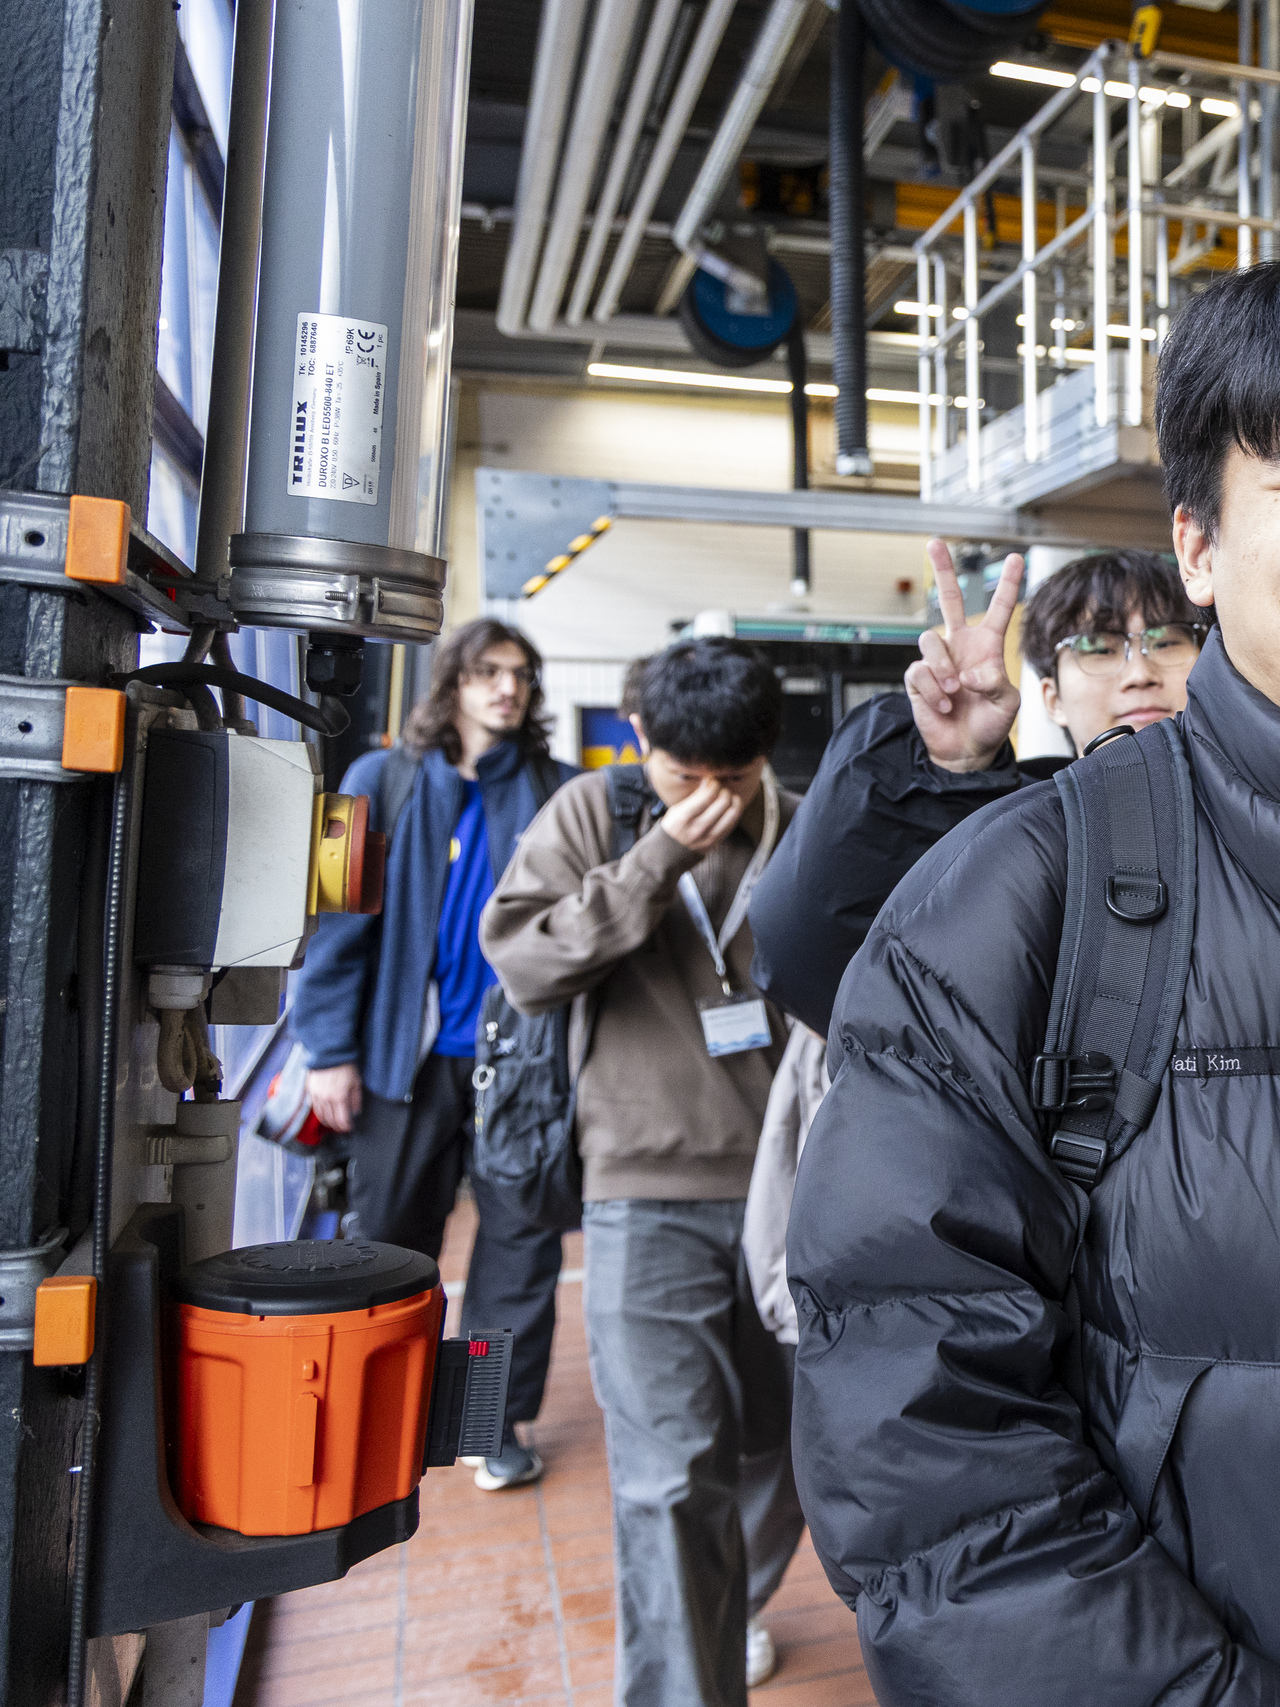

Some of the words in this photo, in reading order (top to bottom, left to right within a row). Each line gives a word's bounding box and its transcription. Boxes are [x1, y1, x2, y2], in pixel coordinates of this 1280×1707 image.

[300, 322, 308, 356] 10145296
[310, 322, 318, 353] 6887640
[308, 358, 316, 376] TOC:
[326, 363, 334, 376] ET
[322, 378, 333, 435] LED5500-840
[292, 401, 307, 485] TRILUX
[318, 447, 328, 488] DUROXO
[1206, 1054, 1242, 1072] Kim
